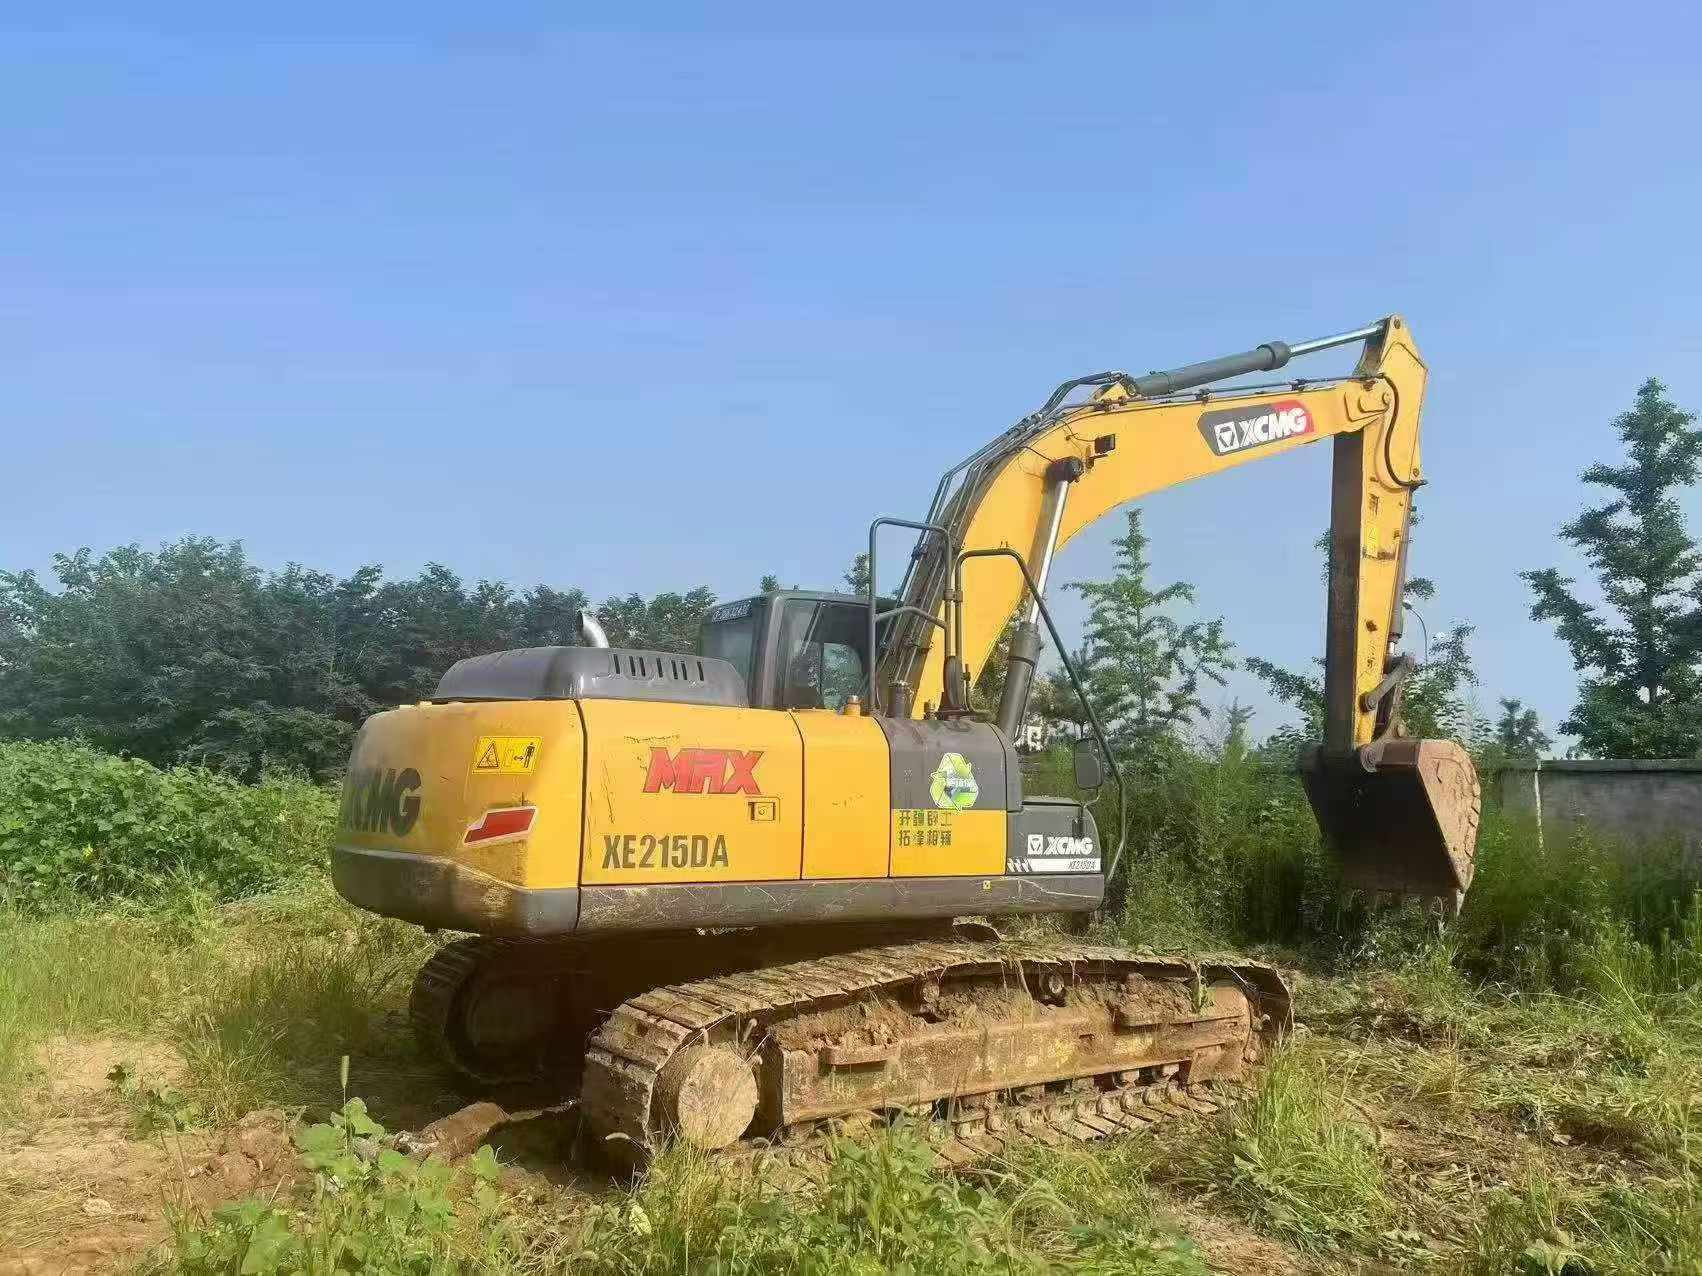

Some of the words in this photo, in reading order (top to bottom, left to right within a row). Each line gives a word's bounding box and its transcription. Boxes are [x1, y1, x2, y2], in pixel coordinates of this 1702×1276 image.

[1239, 407, 1307, 447] XCMG
[643, 747, 764, 794] MAX
[602, 834, 729, 869] XE215DA
[1043, 836, 1094, 855] XCMG
